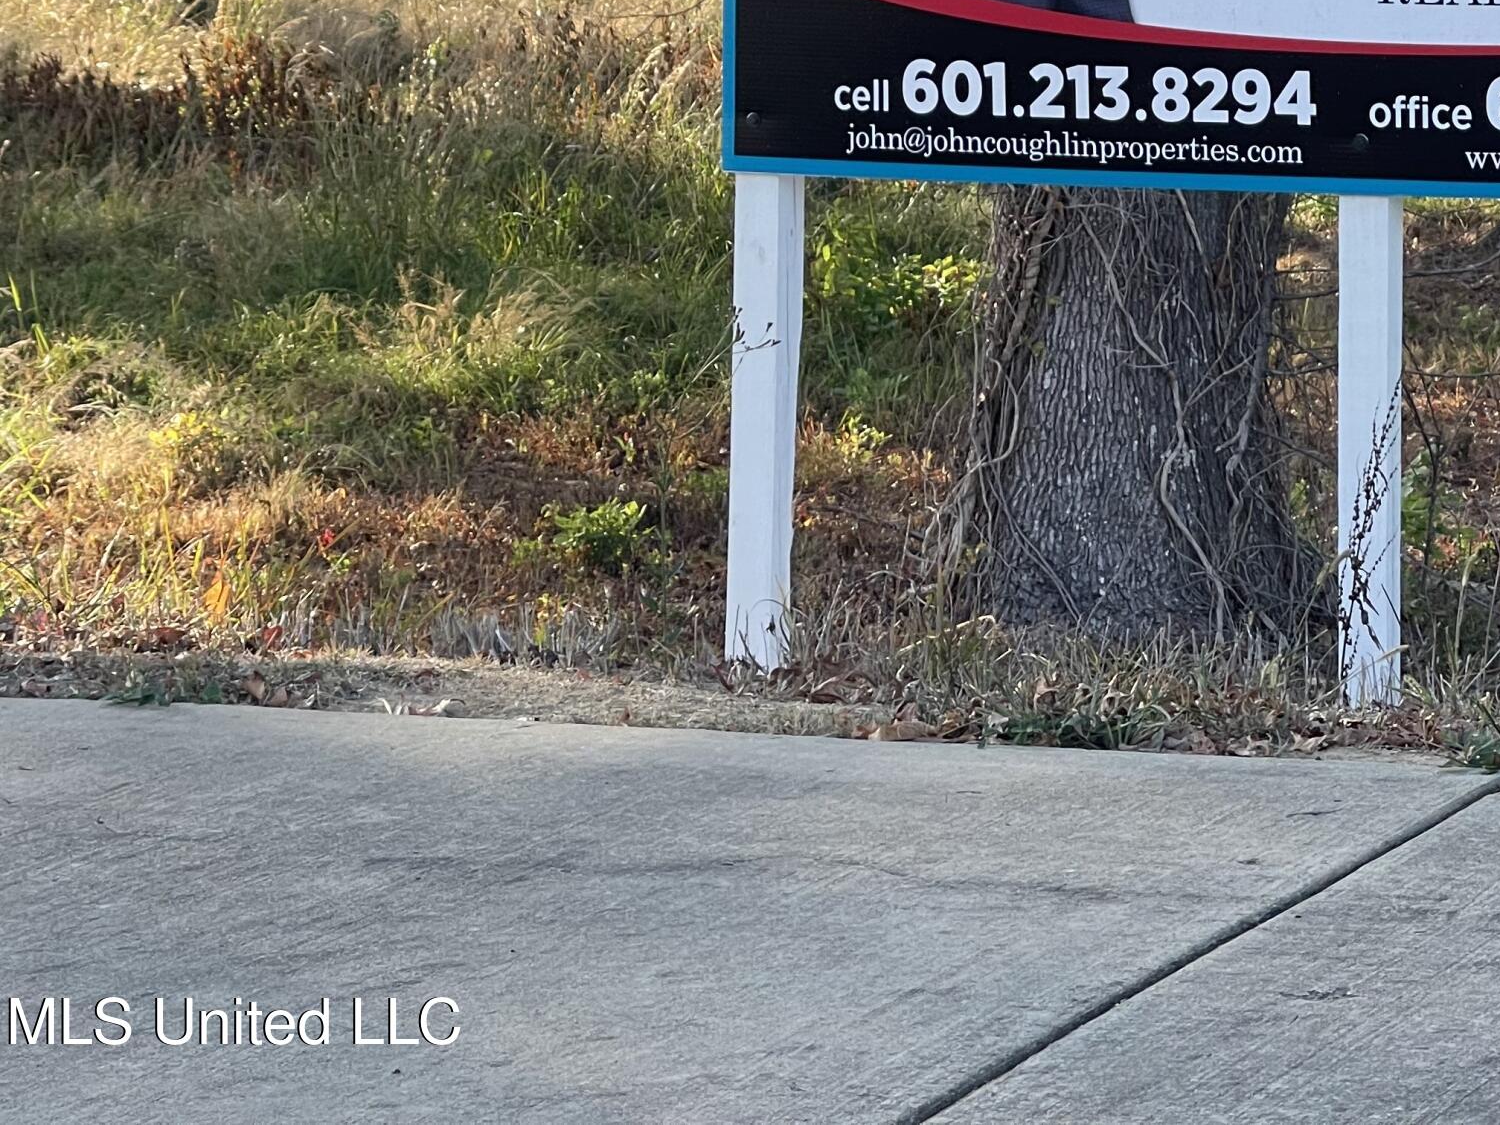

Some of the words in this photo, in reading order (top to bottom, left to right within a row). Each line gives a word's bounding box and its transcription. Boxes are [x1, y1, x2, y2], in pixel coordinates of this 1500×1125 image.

[834, 78, 890, 112] cell
[901, 58, 1318, 126] 601.213.8294
[1368, 95, 1473, 131] office
[846, 122, 1304, 165] john@johncoughlinproperties.com
